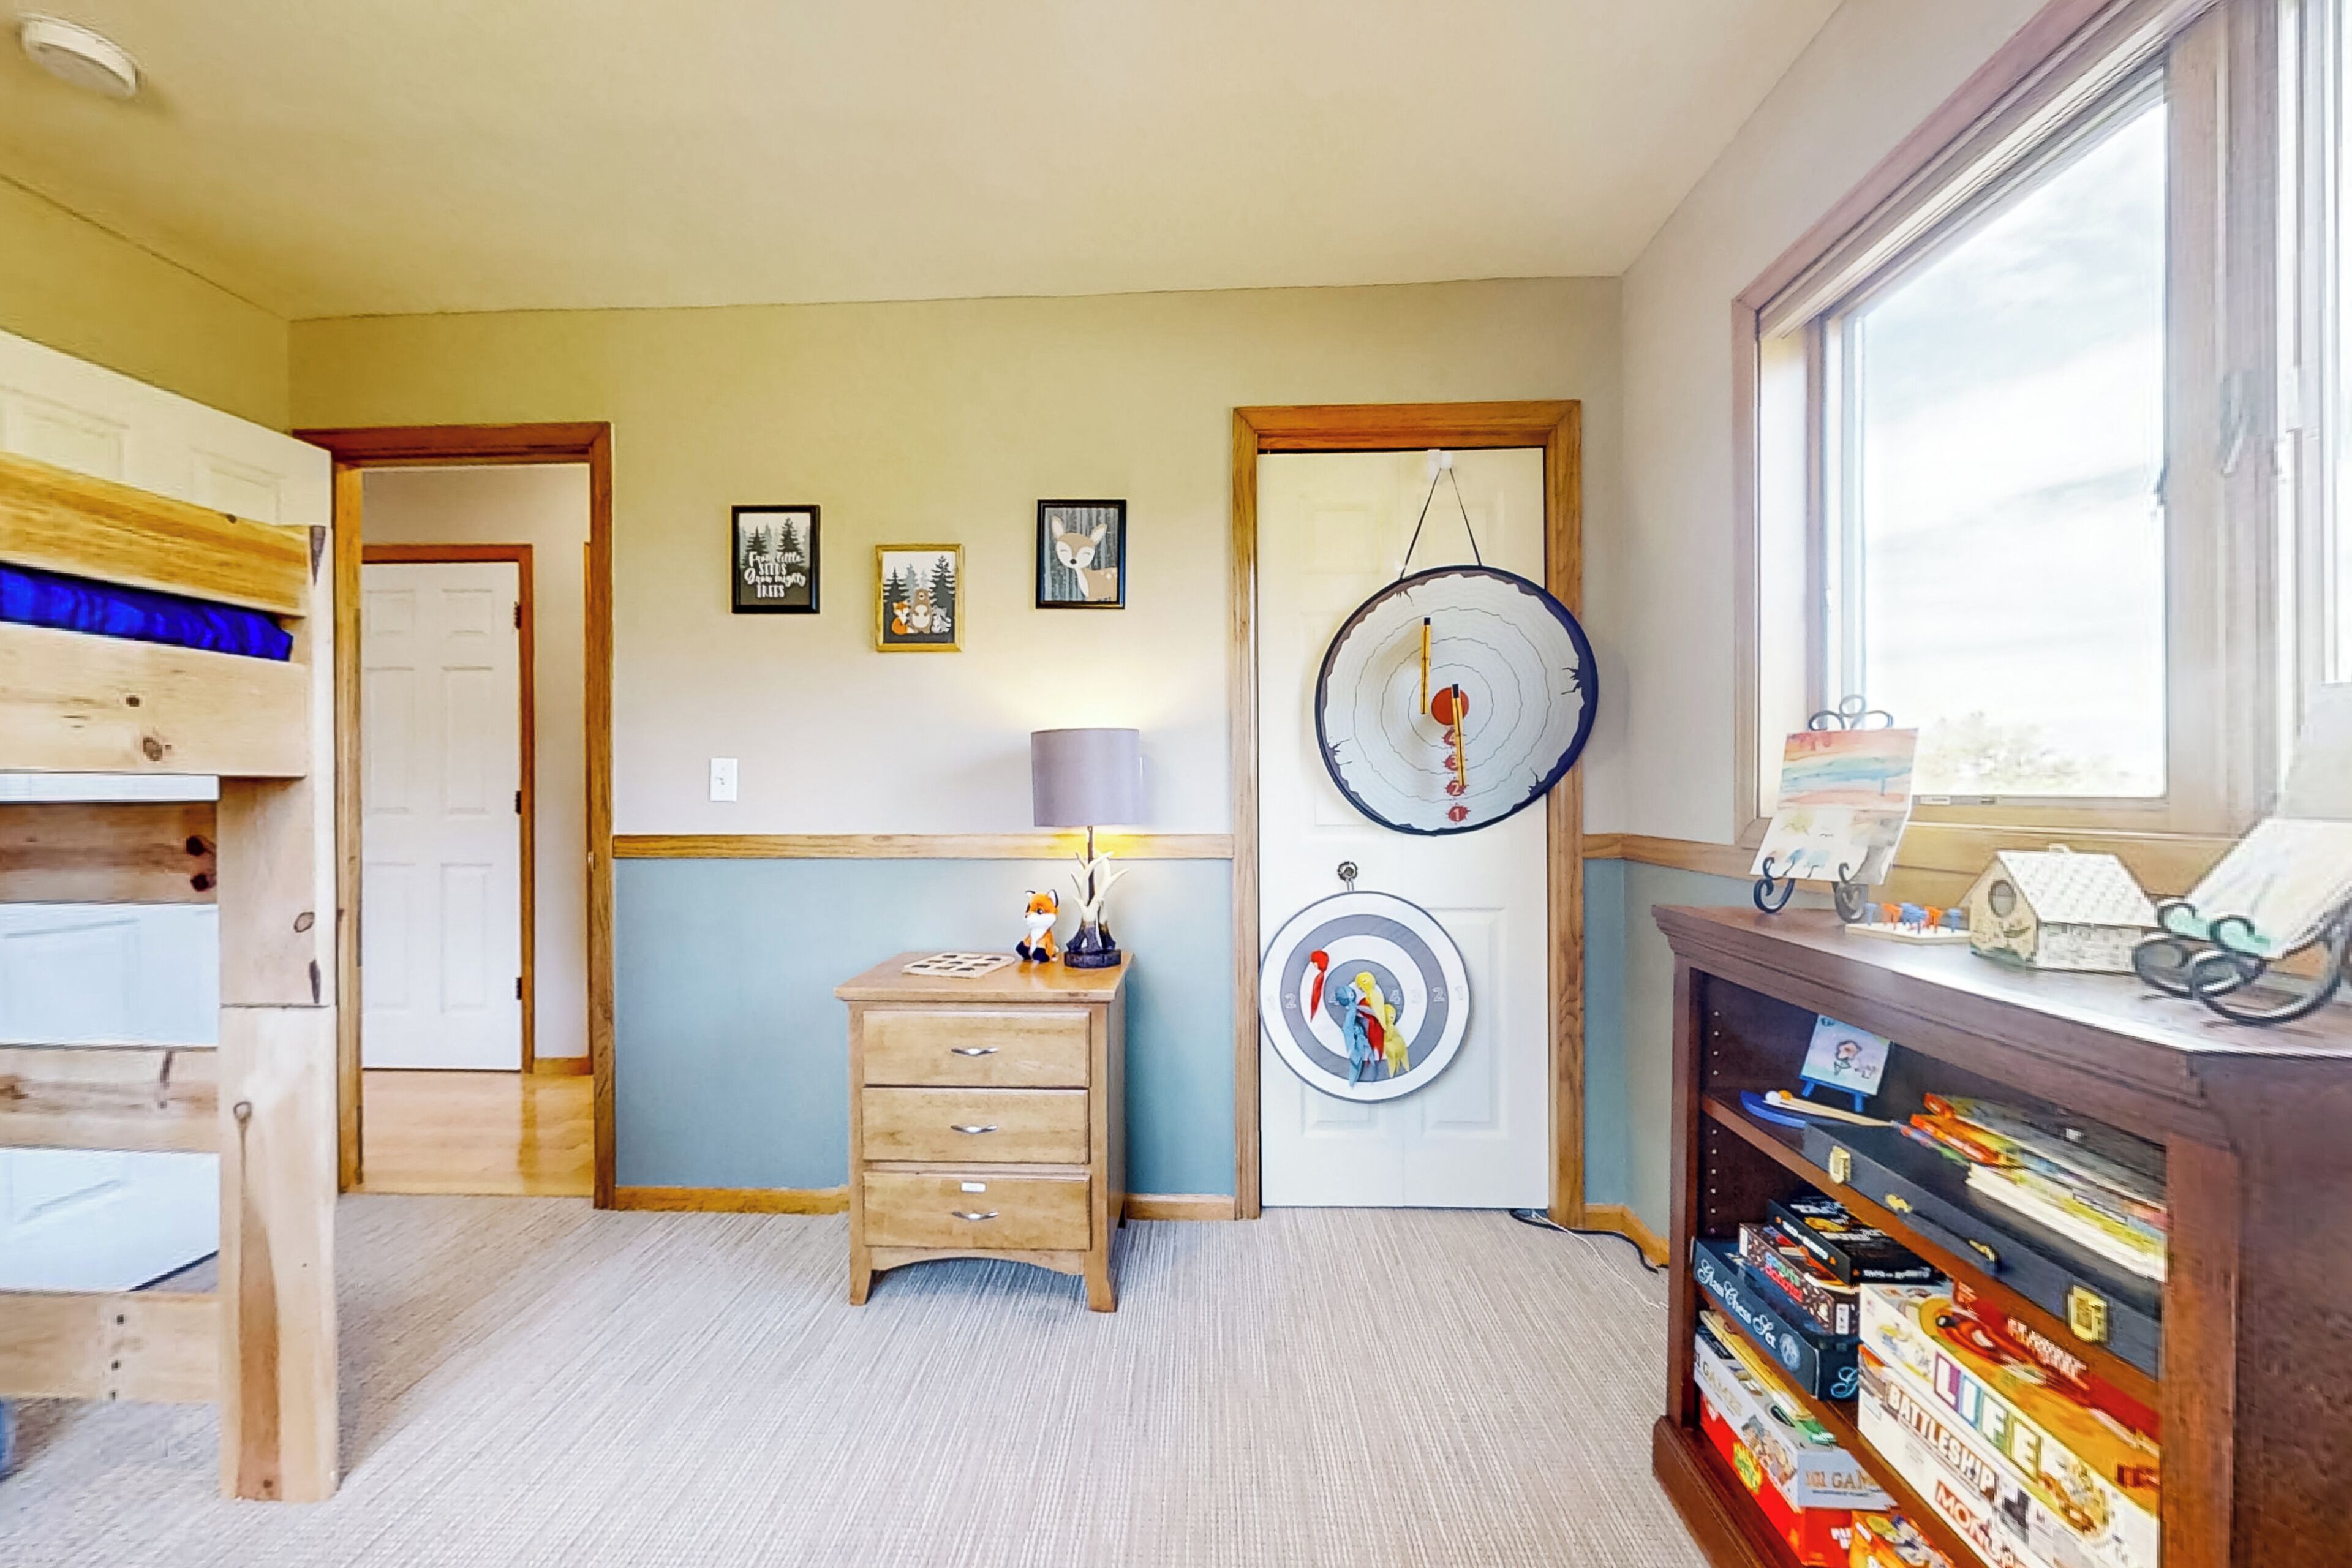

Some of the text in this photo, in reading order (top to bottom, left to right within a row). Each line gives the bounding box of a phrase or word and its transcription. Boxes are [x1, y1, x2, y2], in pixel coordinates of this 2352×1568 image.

[759, 562, 787, 576] SEEDS
[756, 584, 785, 598] TREES
[1450, 756, 1458, 769] 3
[1450, 782, 1460, 796] 2
[1453, 807, 1460, 821] 1
[1284, 993, 1297, 1009] 2
[1389, 989, 1401, 1005] 4
[1431, 987, 1445, 1003] 2
[1724, 1281, 1752, 1324] Chess
[1937, 1355, 2038, 1481] LIFE
[1887, 1381, 1996, 1494] BATTLESHIP
